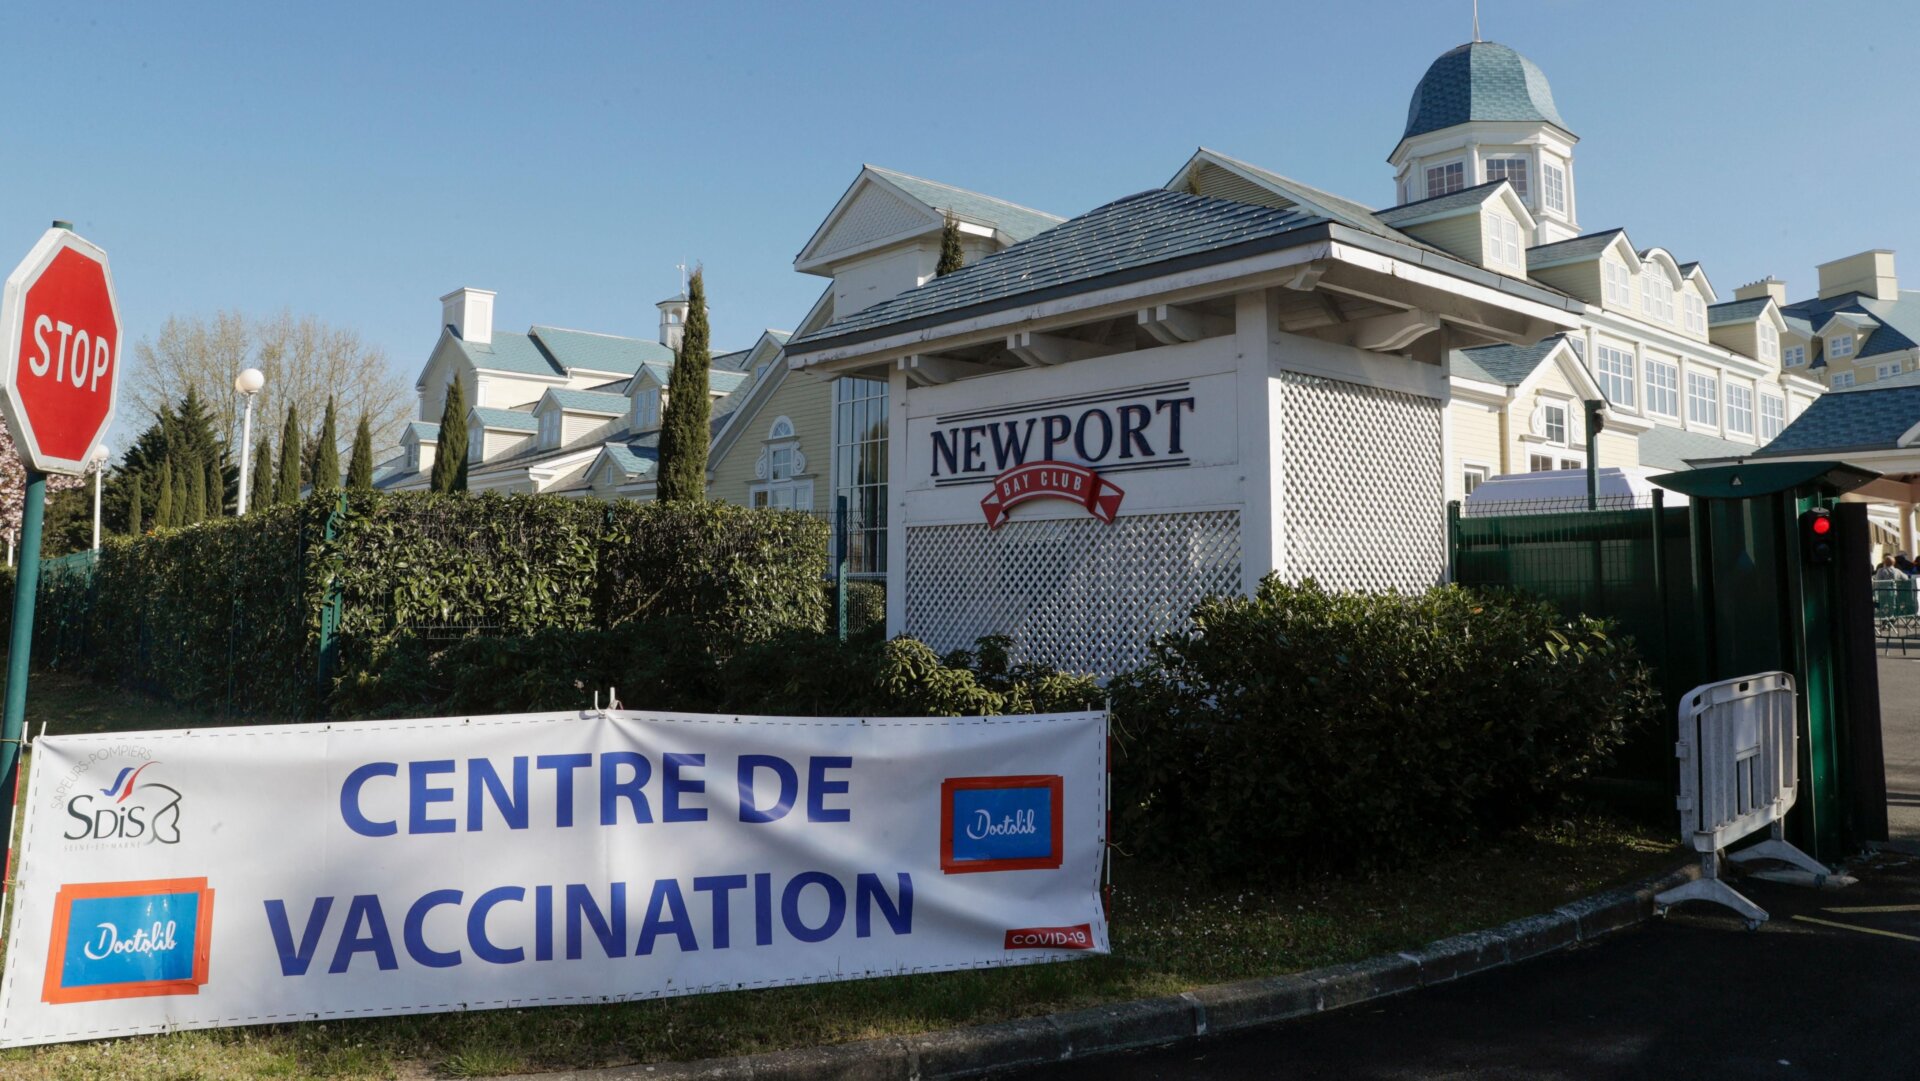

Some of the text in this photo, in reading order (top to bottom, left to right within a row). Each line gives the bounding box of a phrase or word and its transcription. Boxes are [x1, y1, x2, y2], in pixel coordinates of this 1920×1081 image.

[29, 314, 109, 392] STOP
[930, 397, 1195, 477] NEWPORT
[1003, 471, 1081, 497] BAY CLUB
[340, 751, 853, 837] CENTRE DE
[966, 808, 1037, 840] Doctolib
[84, 920, 177, 960] Doctolib
[263, 871, 913, 977] VACCINATION
[1012, 931, 1086, 945] COVID-19
